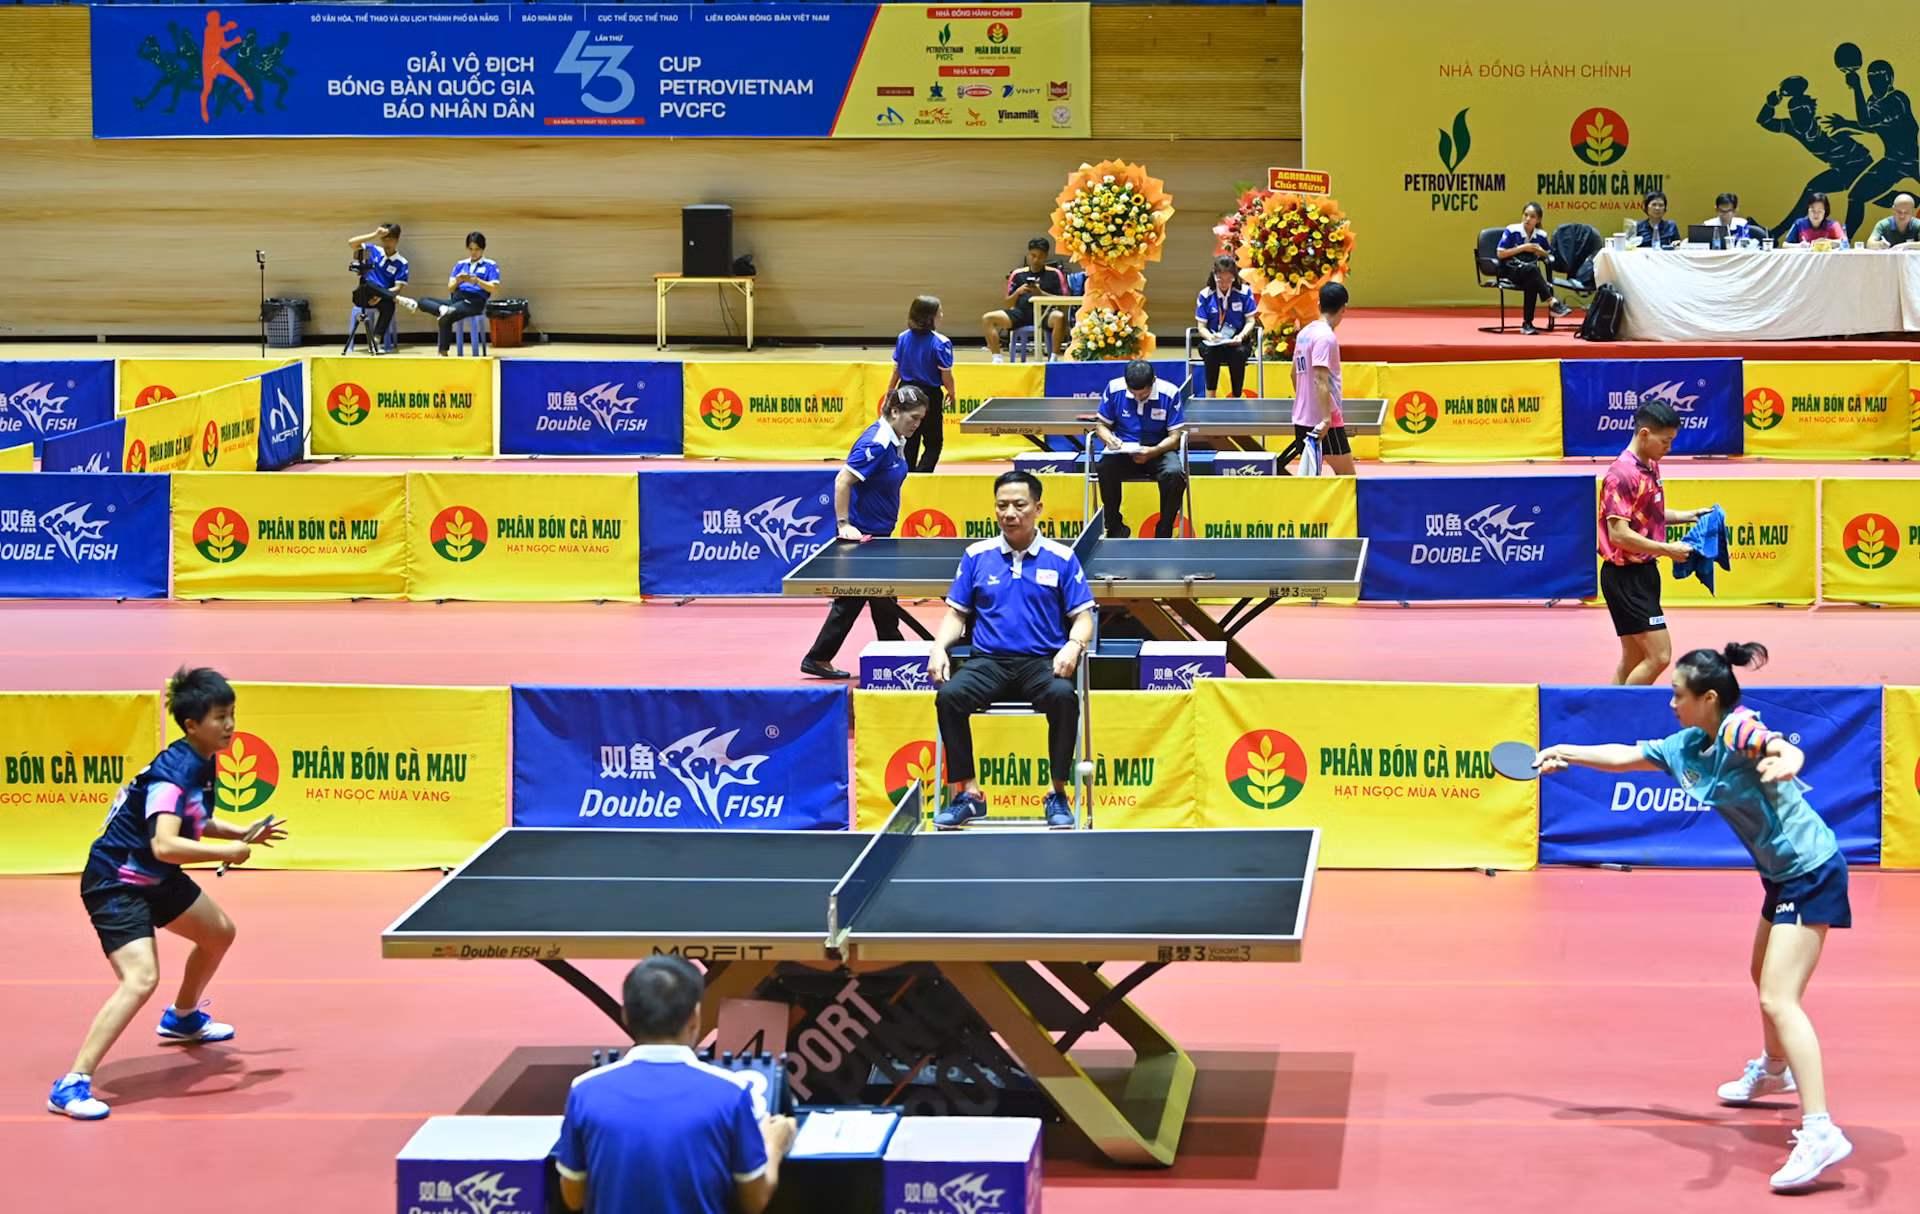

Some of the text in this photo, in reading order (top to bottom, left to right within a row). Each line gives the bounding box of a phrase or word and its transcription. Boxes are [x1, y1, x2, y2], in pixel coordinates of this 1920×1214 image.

[522, 14, 573, 22] BÁO NHÂN DÂN
[598, 15, 612, 23] CỤC
[614, 12, 628, 22] THỂ
[629, 15, 644, 23] DỤC
[645, 12, 658, 22] THỂ
[705, 13, 724, 22] LIÊN
[725, 13, 748, 22] ĐOÀN
[748, 13, 772, 22] BÓNG
[774, 13, 792, 22] BÀN
[792, 13, 810, 22] VIỆT
[406, 51, 534, 77] GIẢI VÔ ĐỊCH
[553, 30, 635, 114] 43
[659, 56, 702, 73] CUP
[1439, 58, 1632, 78] NHÀ ĐỒNG HÀNH CHÍNH
[328, 72, 535, 96] BÓNG BÀN QUỐC GIA
[660, 80, 814, 95] PETROVIETNAM
[383, 98, 535, 118] BÁO NHÂN DÂN
[660, 102, 726, 118] PVCFC
[998, 109, 1039, 119] Vinamilk
[1278, 172, 1323, 182] AGRIBANK
[1404, 174, 1506, 192] PETROVIETNAM
[1537, 170, 1575, 195] PHÂN
[1579, 170, 1608, 195] BÓN
[1612, 170, 1630, 195] CÀ
[1274, 180, 1326, 194] Chúc Mừng
[1431, 194, 1478, 212] PVCFC
[1623, 199, 1645, 210] VÀN
[377, 389, 472, 408] PHÂN BÓN CÀ MAU
[750, 394, 844, 413] PHÂN BÓN CÀ MAU
[1444, 394, 1540, 414] PHÂN BÓN CÀ MAU
[1792, 394, 1888, 412] PHÂN BÓN CÀ MAU
[45, 418, 78, 430] FISH
[536, 415, 648, 432] Double FISH
[258, 516, 378, 540] PHÂN BÓN CÀ MAU
[496, 514, 621, 540] PHÂN BÓN CÀ MAU
[1205, 517, 1242, 538] PHÂN
[1246, 517, 1273, 538] BÓN
[1278, 517, 1295, 538] CÀ
[1738, 522, 1756, 546] CÀ
[1760, 525, 1788, 546] MAU
[0, 543, 118, 560] OUBLE FISH
[268, 544, 368, 556] HẠT NGỌC MÙA VÀNG
[506, 543, 610, 555] HẠT NGỌC MÙA VÀNG
[688, 540, 825, 561] Double FIS
[1410, 544, 1544, 564] DOUBLE FISH
[832, 586, 862, 594] Double
[6, 751, 124, 784] BÓN CÀ MAU
[292, 746, 467, 782] PHÂN BÓN CÀ MAU
[979, 752, 1032, 786] PHÂN
[1320, 742, 1496, 779] PHÂN BÓN CÀ MAU
[1114, 758, 1154, 786] MAU
[36, 790, 108, 804] MÙA VÀNG
[306, 787, 450, 803] HẠT NGỌC MÙA VÀNG
[994, 795, 1019, 808] HẠT
[1100, 793, 1136, 806] VÀNG
[1334, 784, 1480, 800] HẠT NGỌC MÙA VÀNG
[578, 788, 784, 818] Double FISH
[460, 945, 541, 958] Double FISH
